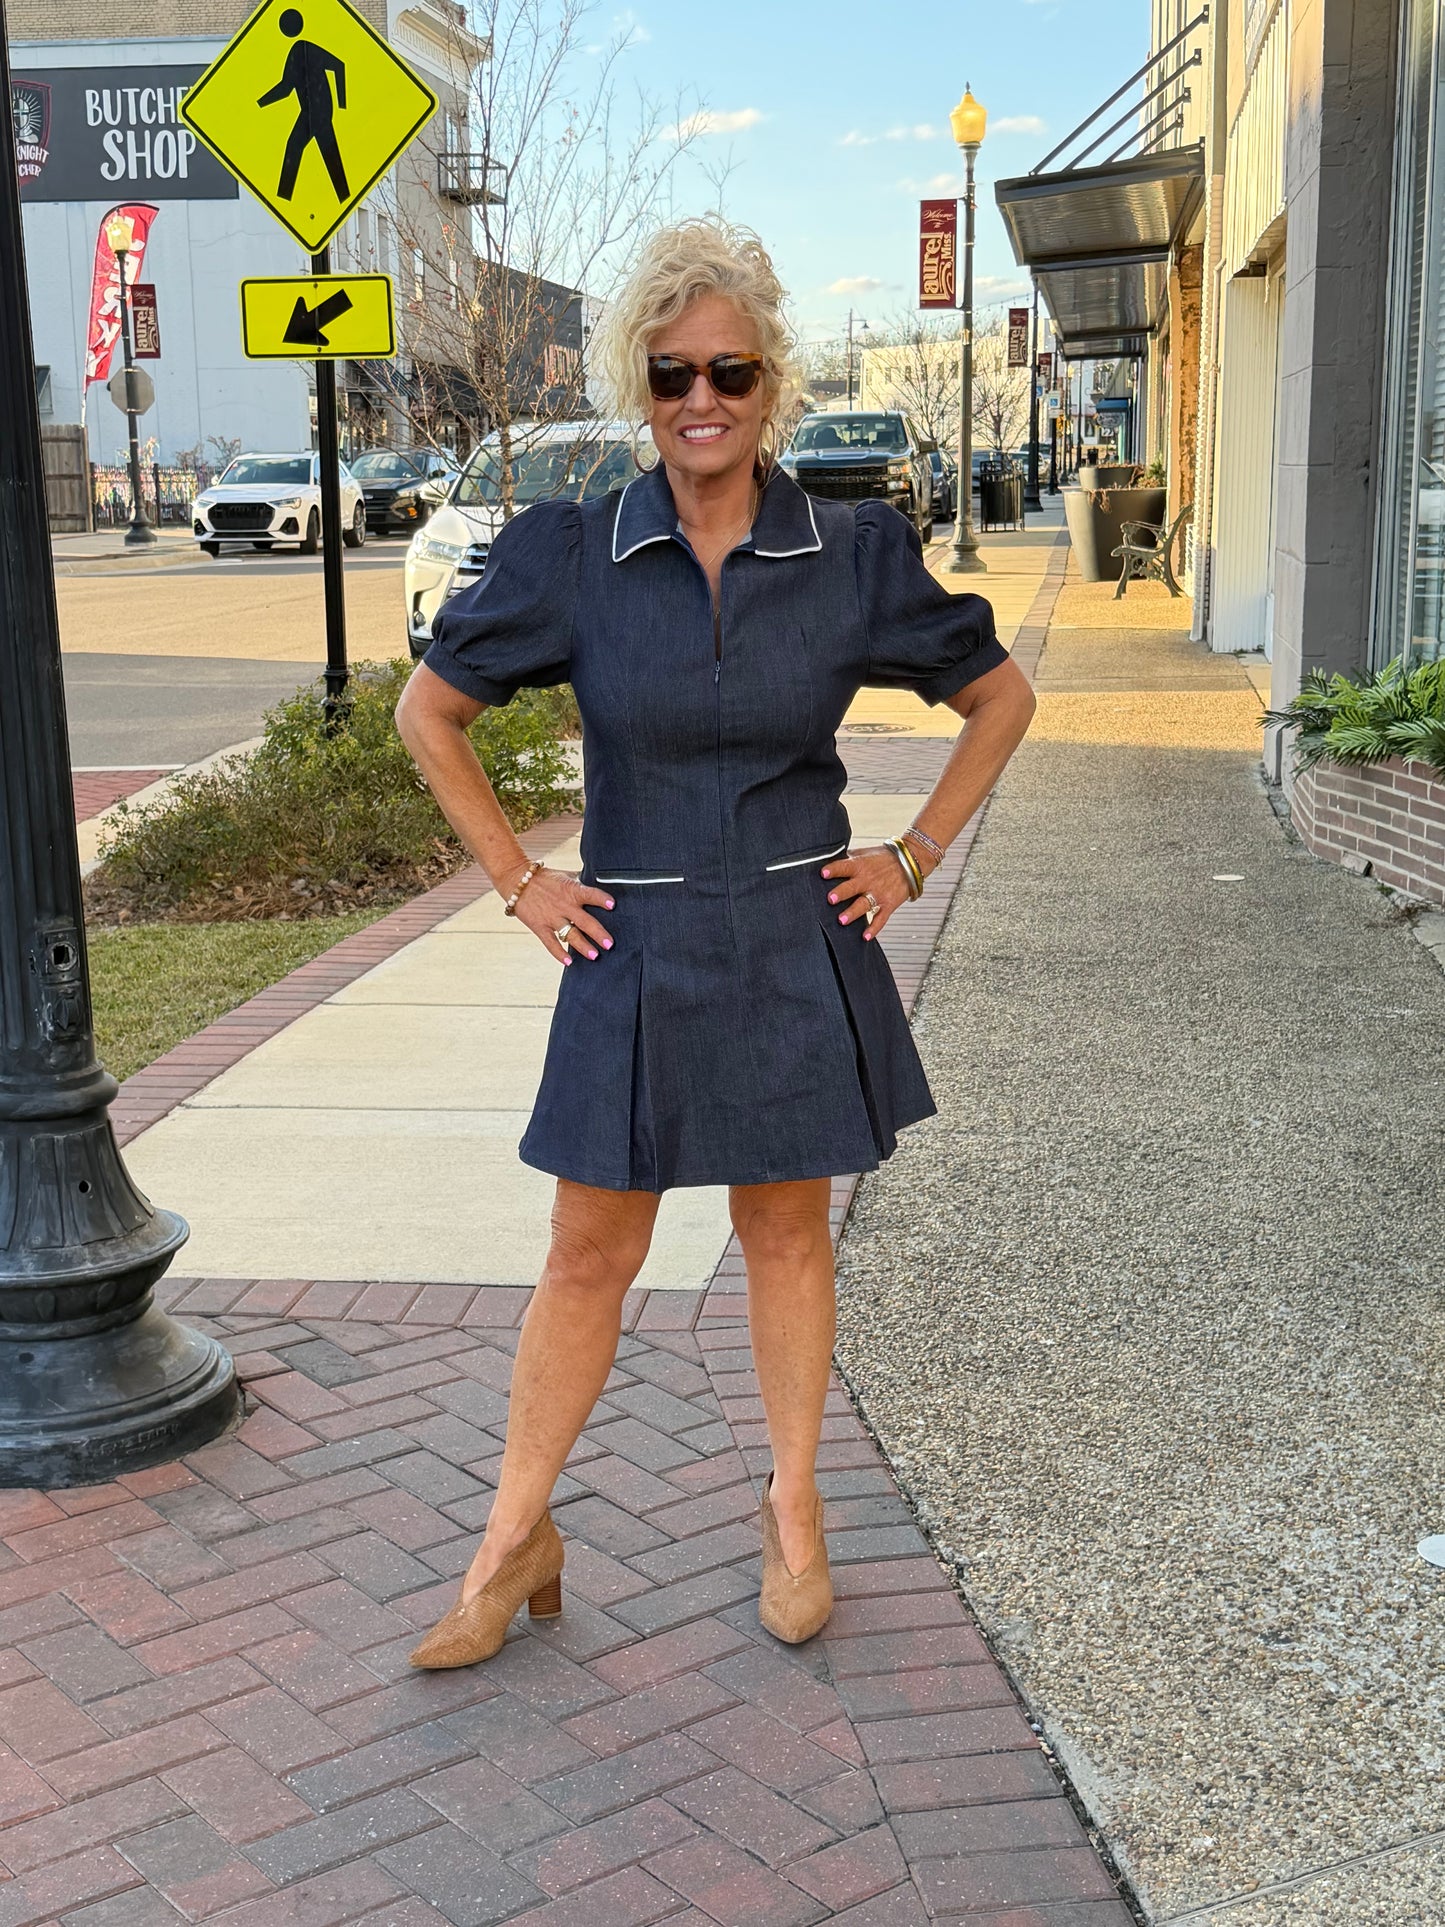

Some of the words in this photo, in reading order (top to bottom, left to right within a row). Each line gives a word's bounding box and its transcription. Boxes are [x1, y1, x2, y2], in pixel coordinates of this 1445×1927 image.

[85, 86, 194, 126] BUTCHE
[18, 163, 42, 177] CHER
[100, 129, 197, 181] SHOP
[920, 231, 949, 301] Laurel
[133, 305, 155, 353] Laurel
[1009, 325, 1023, 363] Laurel
